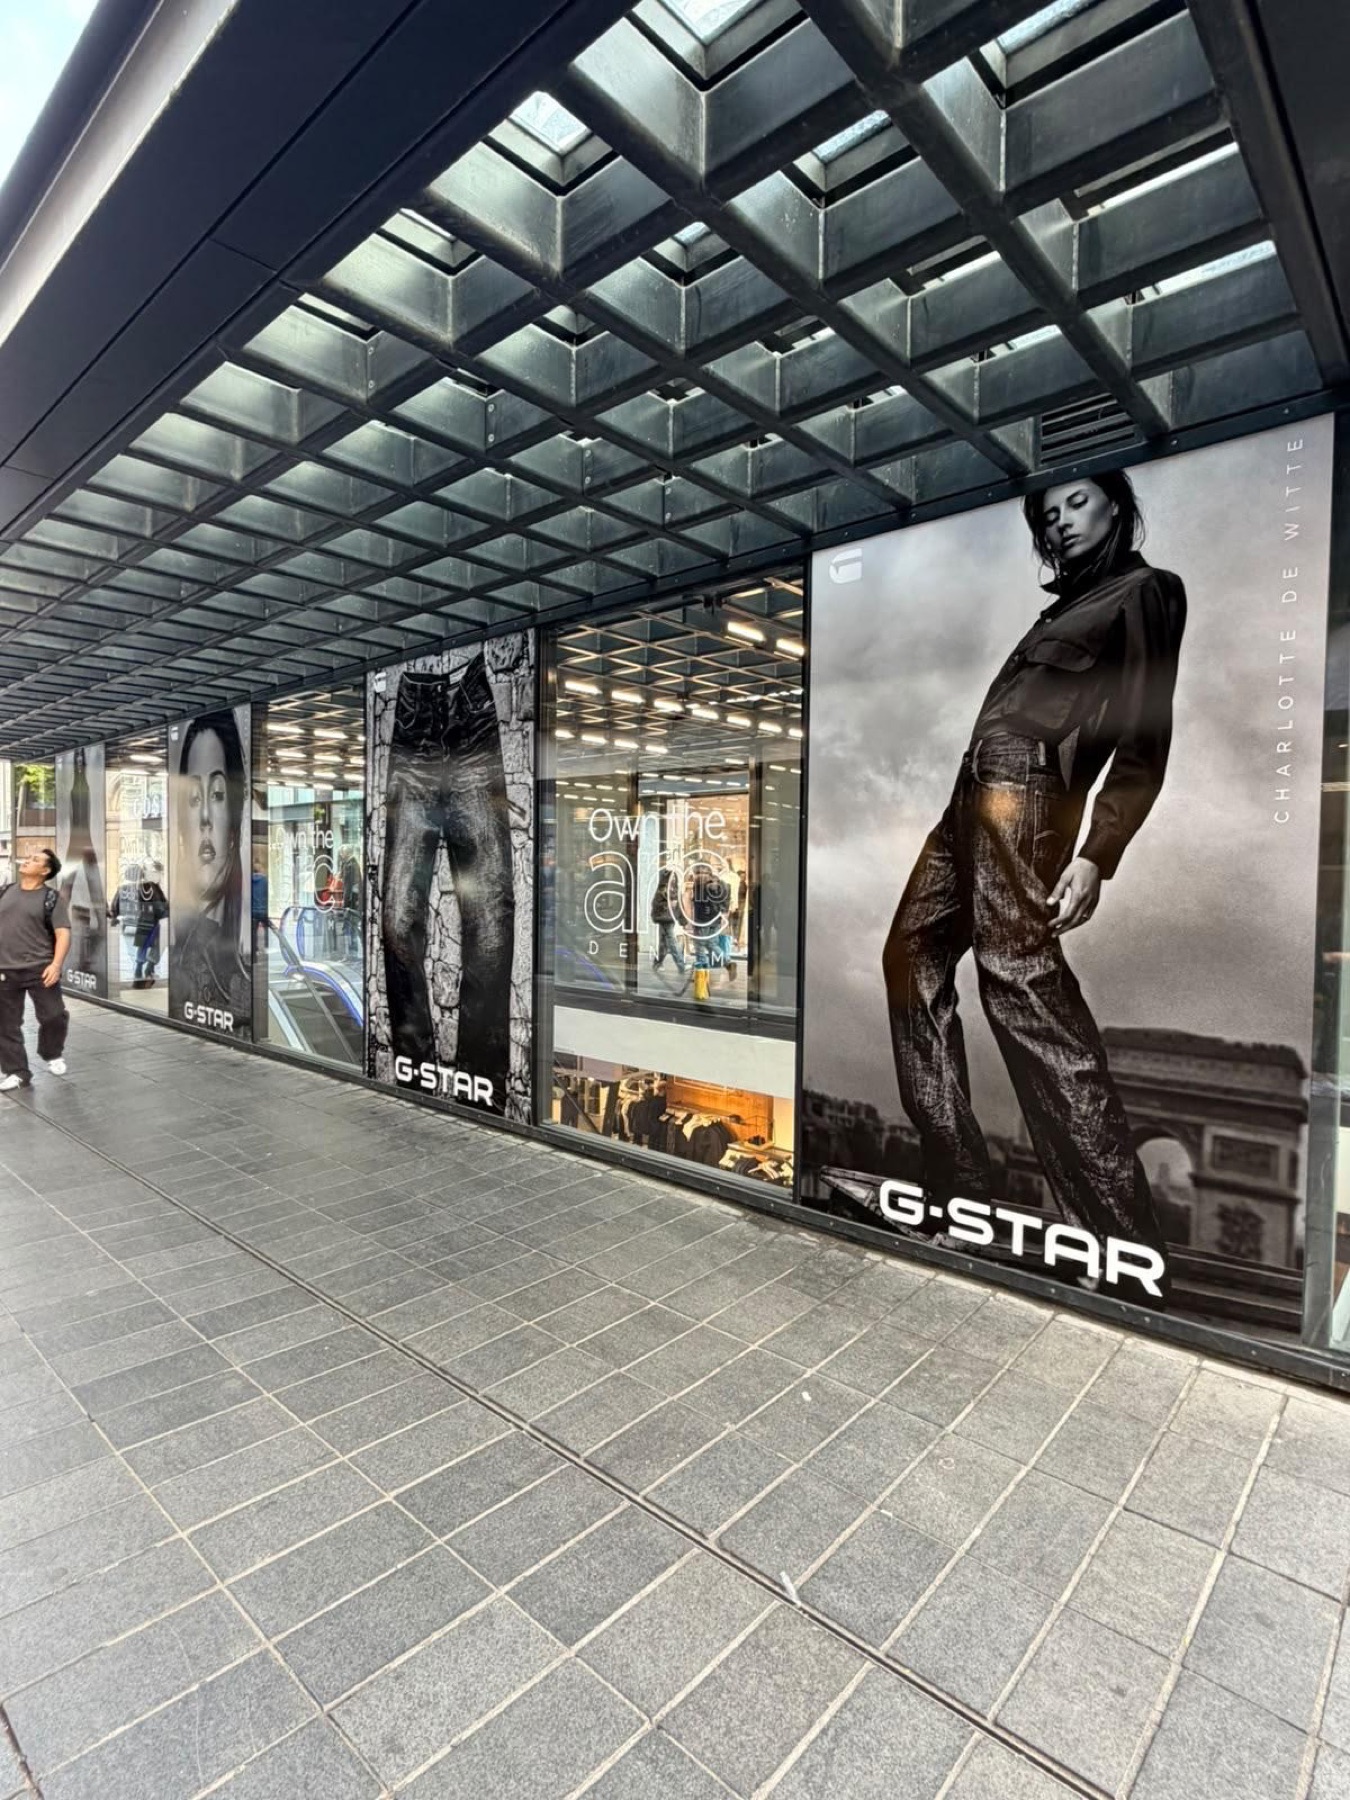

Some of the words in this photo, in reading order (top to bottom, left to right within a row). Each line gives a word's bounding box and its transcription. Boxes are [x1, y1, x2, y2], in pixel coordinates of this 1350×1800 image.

[1284, 438, 1304, 541] WITTE
[1281, 566, 1299, 603] DE
[1273, 628, 1297, 824] CHARLOTTE
[589, 807, 660, 843] Own
[662, 801, 726, 839] the
[587, 940, 725, 968] DENIM
[66, 968, 98, 990] G-STAR
[183, 1000, 235, 1033] G-STAR
[394, 1055, 495, 1107] G-STAR
[878, 1179, 1166, 1298] G-STAR
